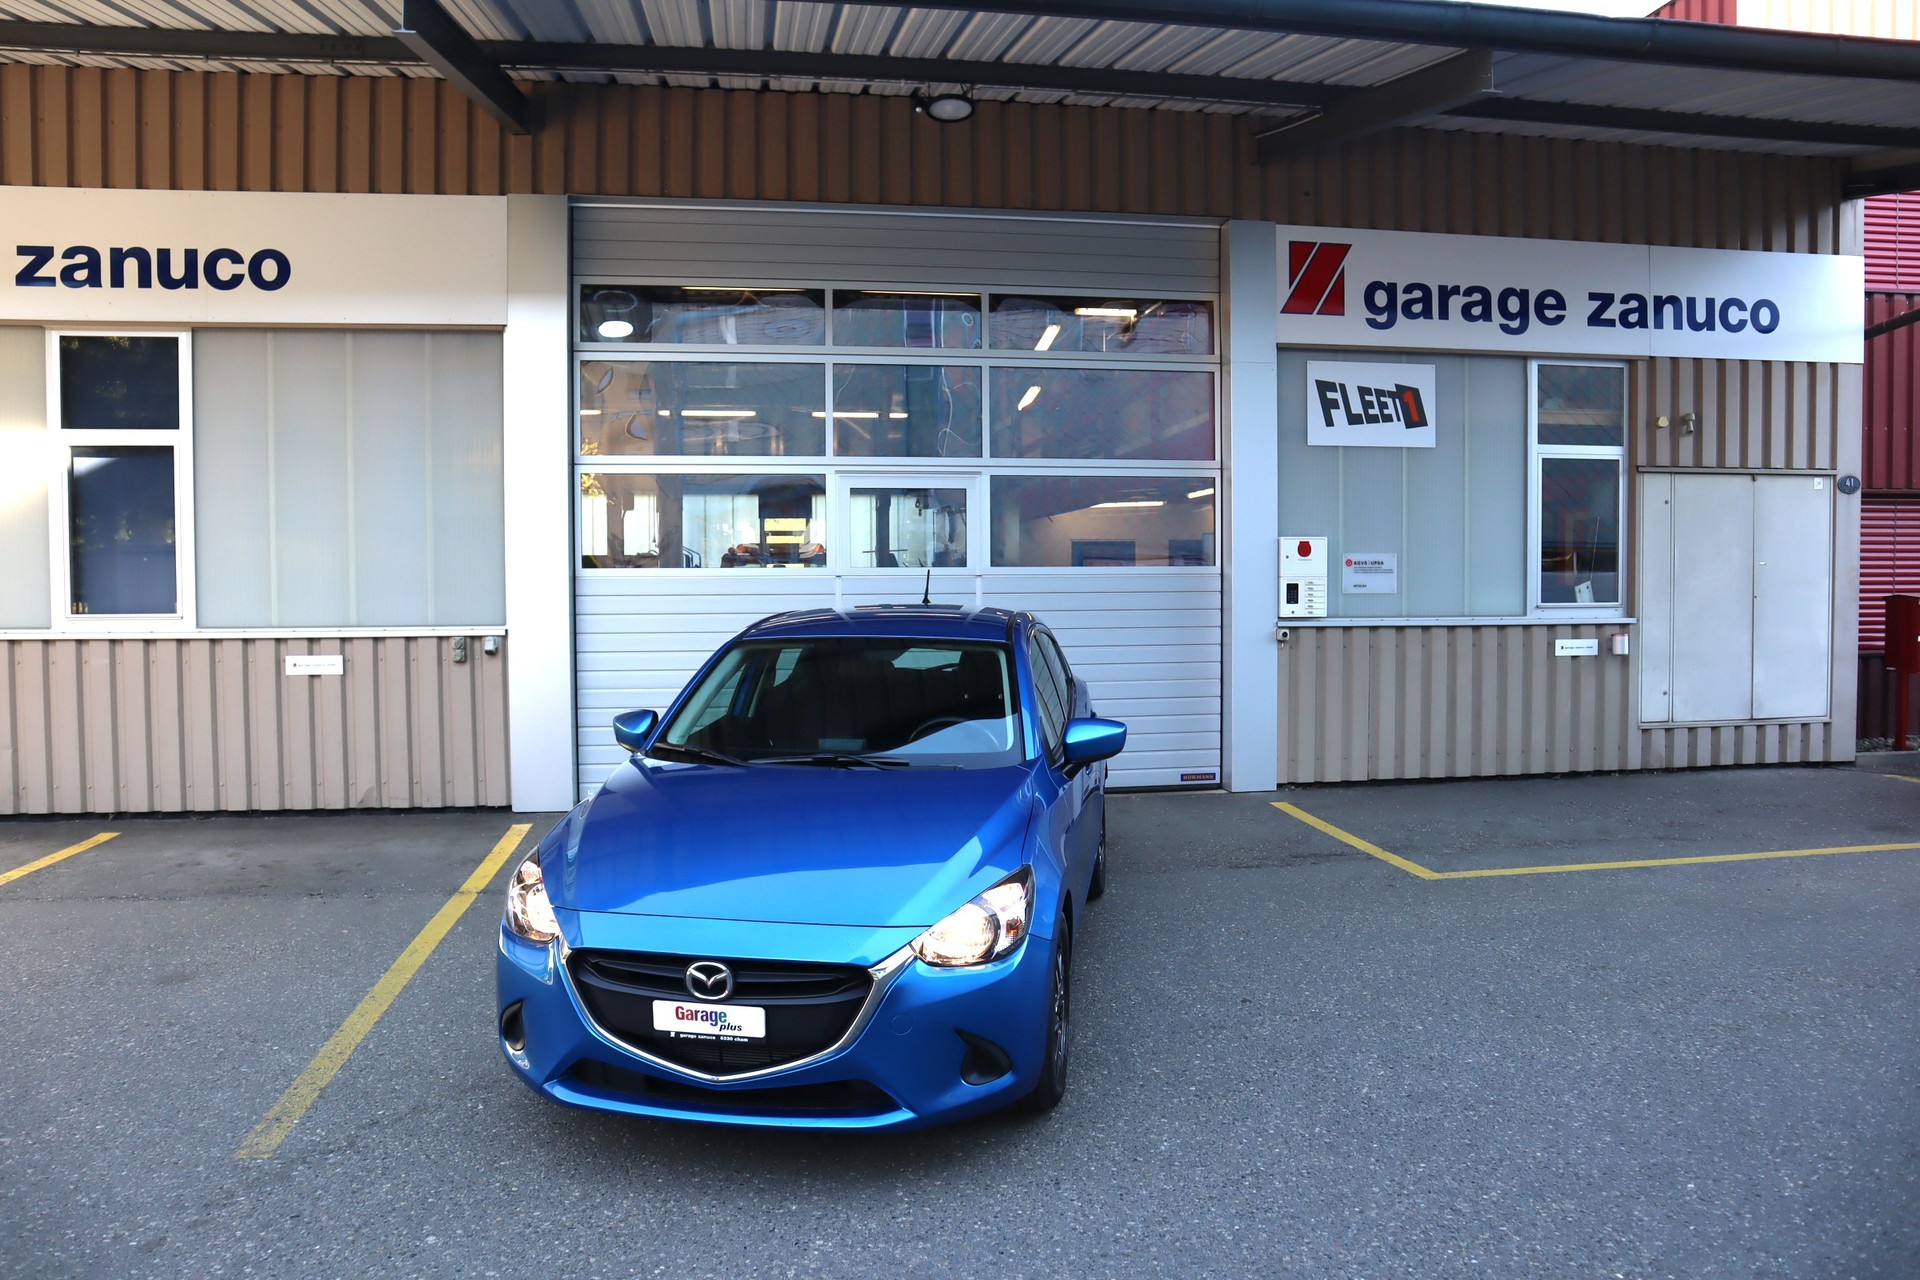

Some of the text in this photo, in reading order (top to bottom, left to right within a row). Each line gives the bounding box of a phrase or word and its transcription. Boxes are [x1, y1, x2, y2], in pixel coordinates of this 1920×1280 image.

[15, 245, 292, 291] zanuco
[1363, 280, 1780, 336] garage zanuco
[1845, 477, 1854, 487] 41
[675, 1005, 728, 1027] Garage
[719, 1022, 743, 1032] plus
